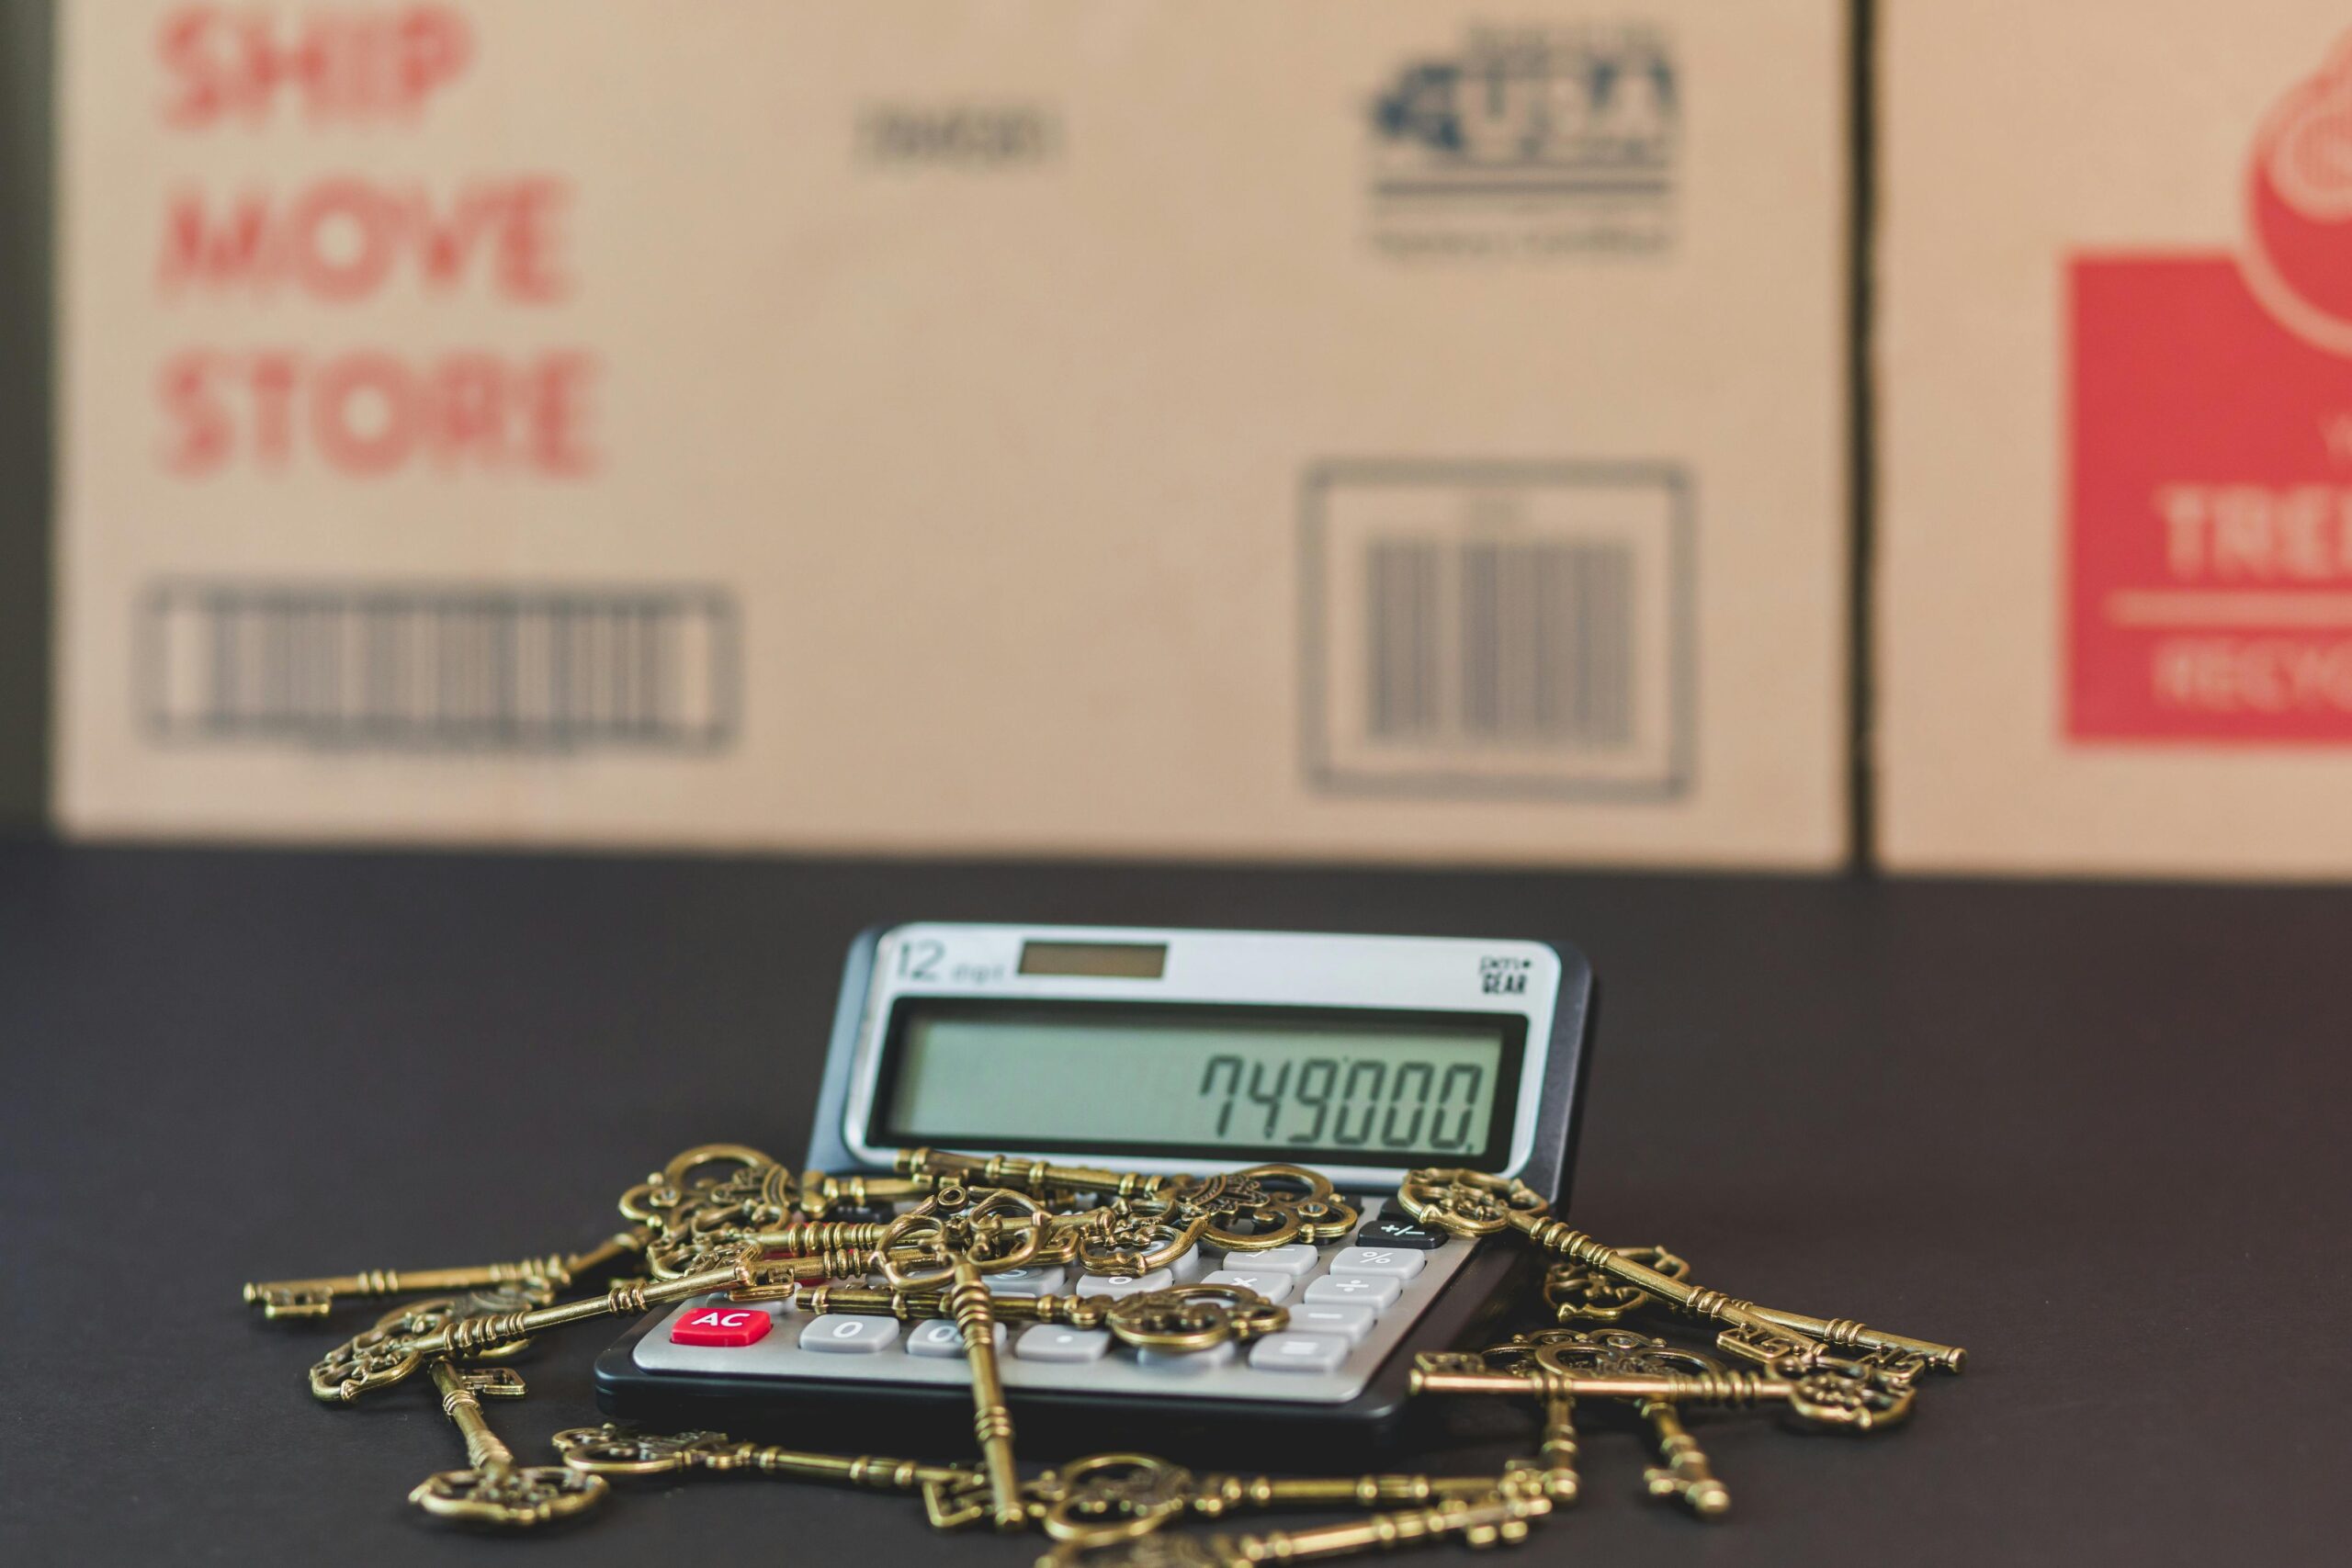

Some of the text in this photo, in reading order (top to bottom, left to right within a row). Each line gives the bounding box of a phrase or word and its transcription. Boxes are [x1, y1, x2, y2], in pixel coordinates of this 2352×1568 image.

[158, 4, 472, 127] SHIP
[160, 180, 575, 301] MOVE
[159, 351, 603, 479] STORE
[899, 939, 944, 982] 12
[1482, 973, 1528, 994] GEAR
[691, 1312, 751, 1327] AC
[832, 1321, 865, 1338] 0
